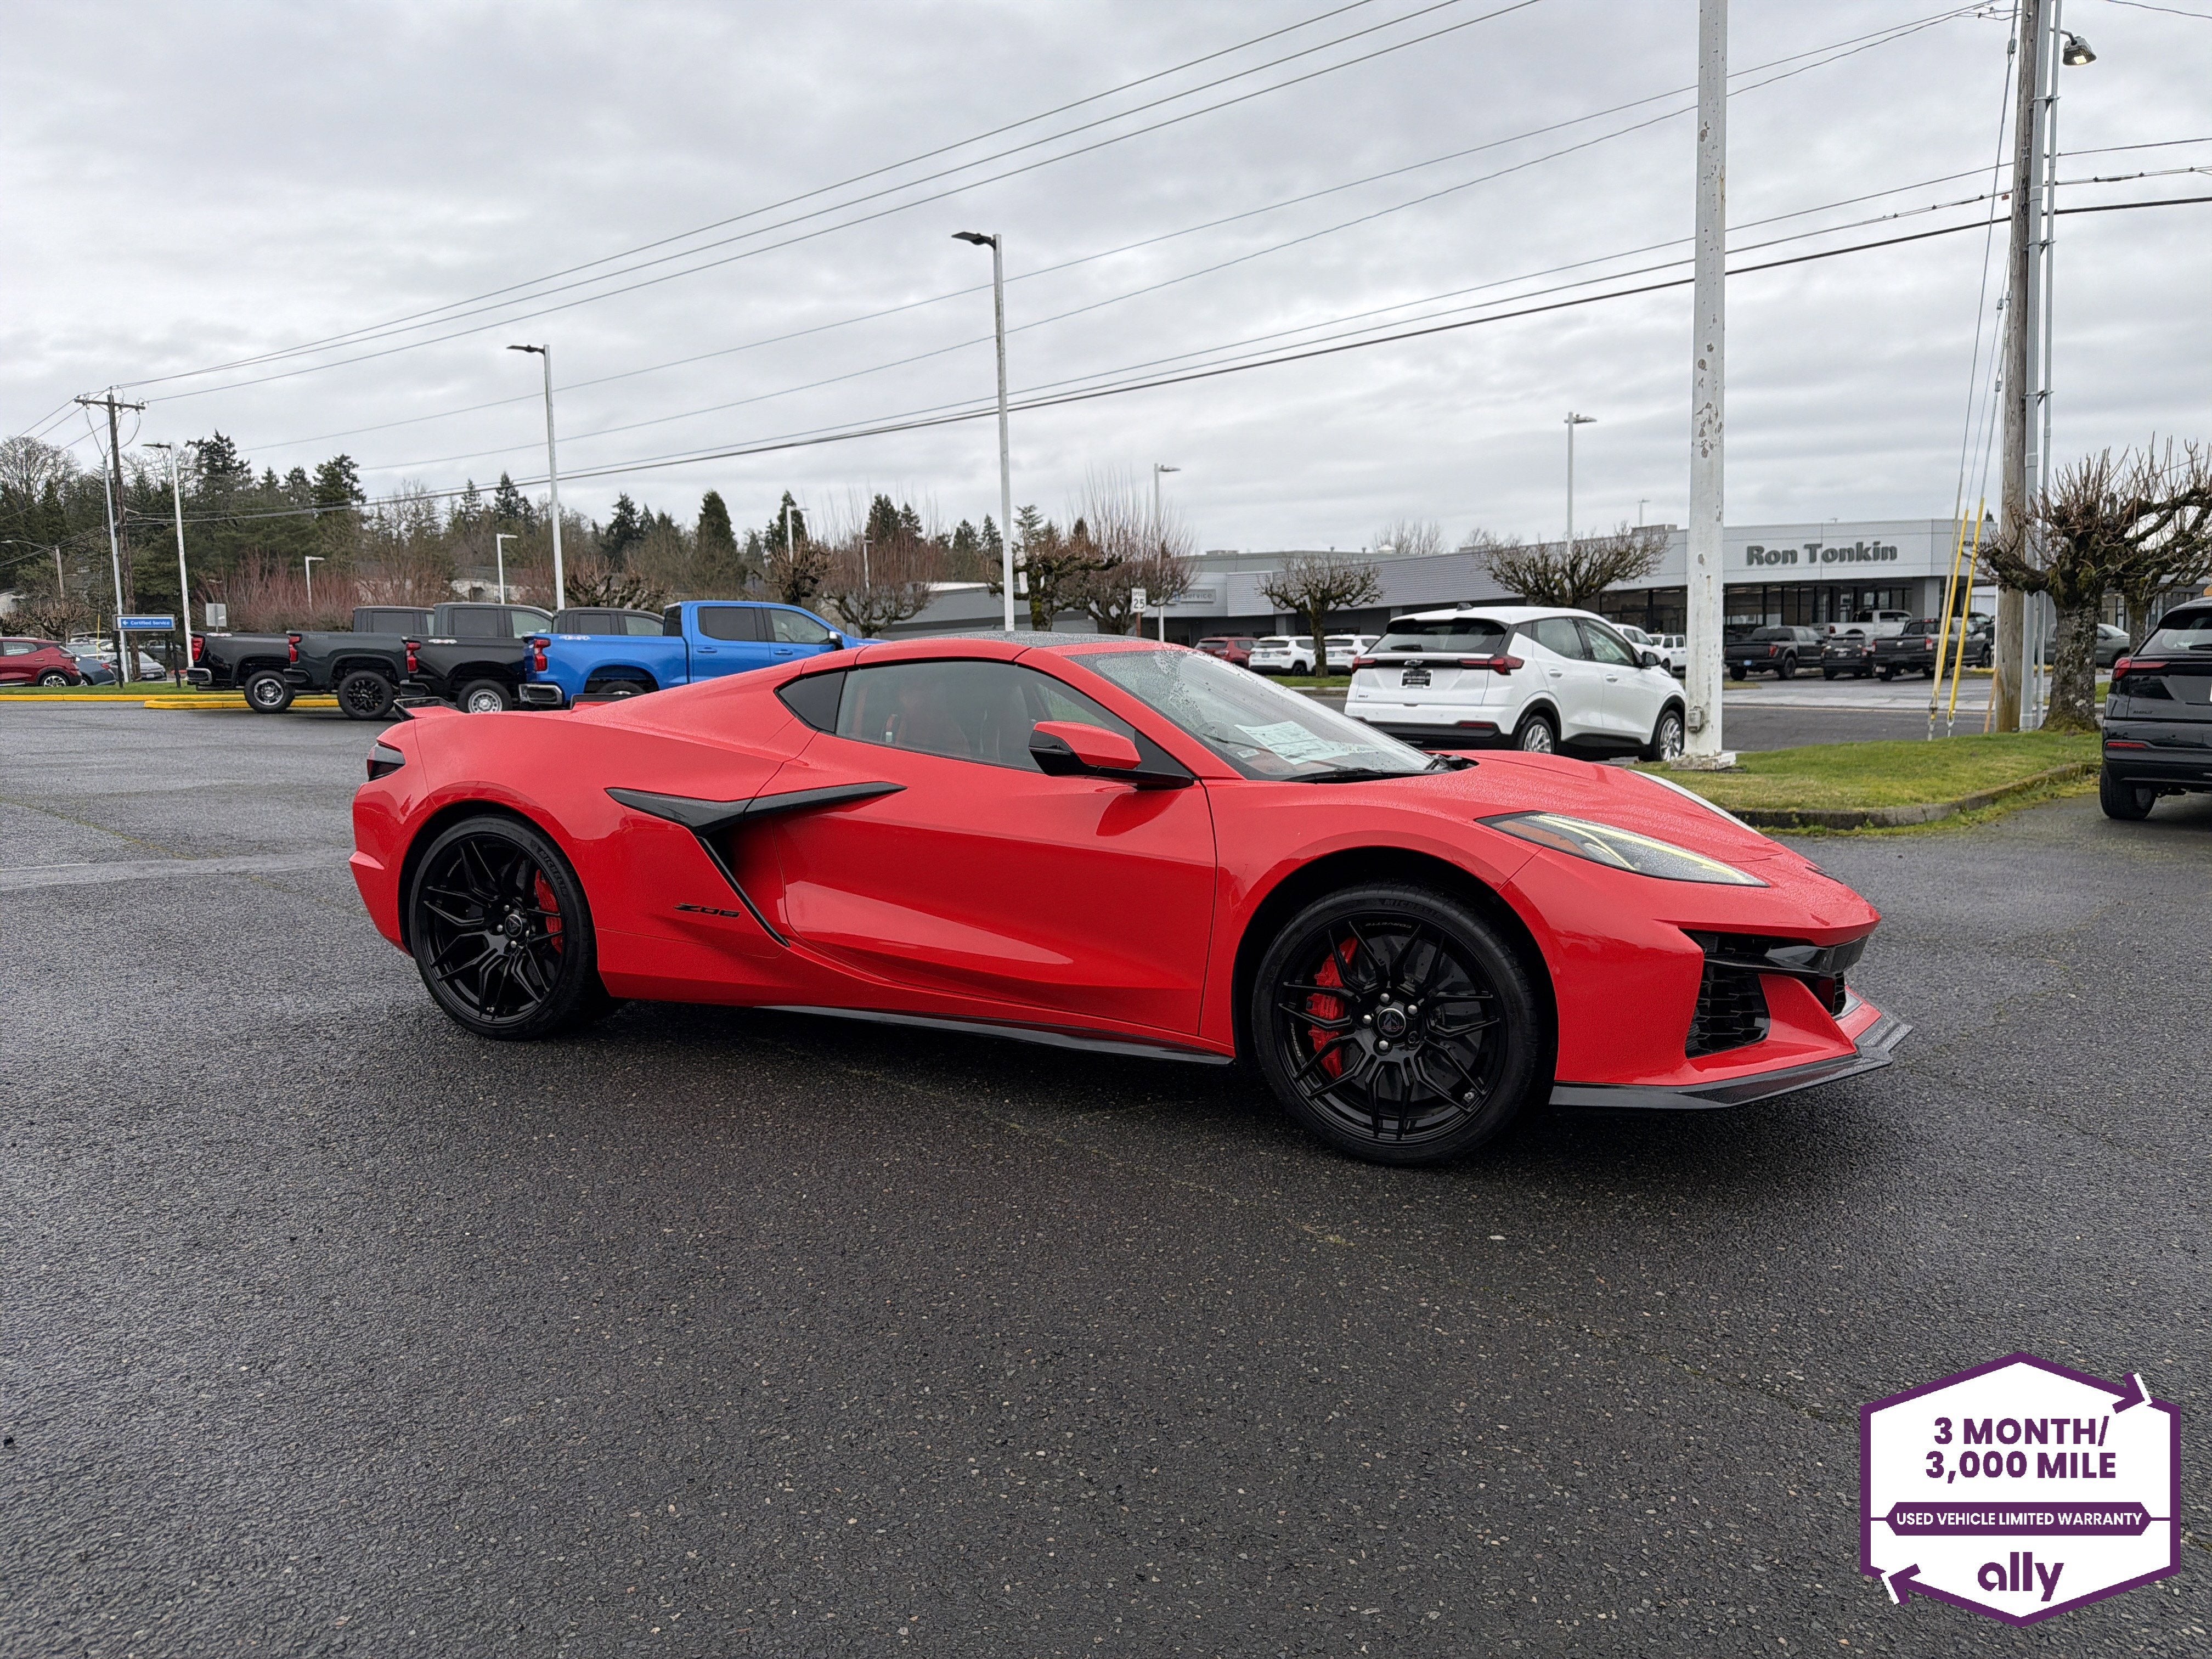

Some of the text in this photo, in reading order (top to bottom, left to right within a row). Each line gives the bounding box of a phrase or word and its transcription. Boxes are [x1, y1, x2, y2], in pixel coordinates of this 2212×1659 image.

[1746, 540, 1898, 566] Ron Tonkin
[1133, 598, 1145, 609] 25
[673, 903, 740, 918] Z06
